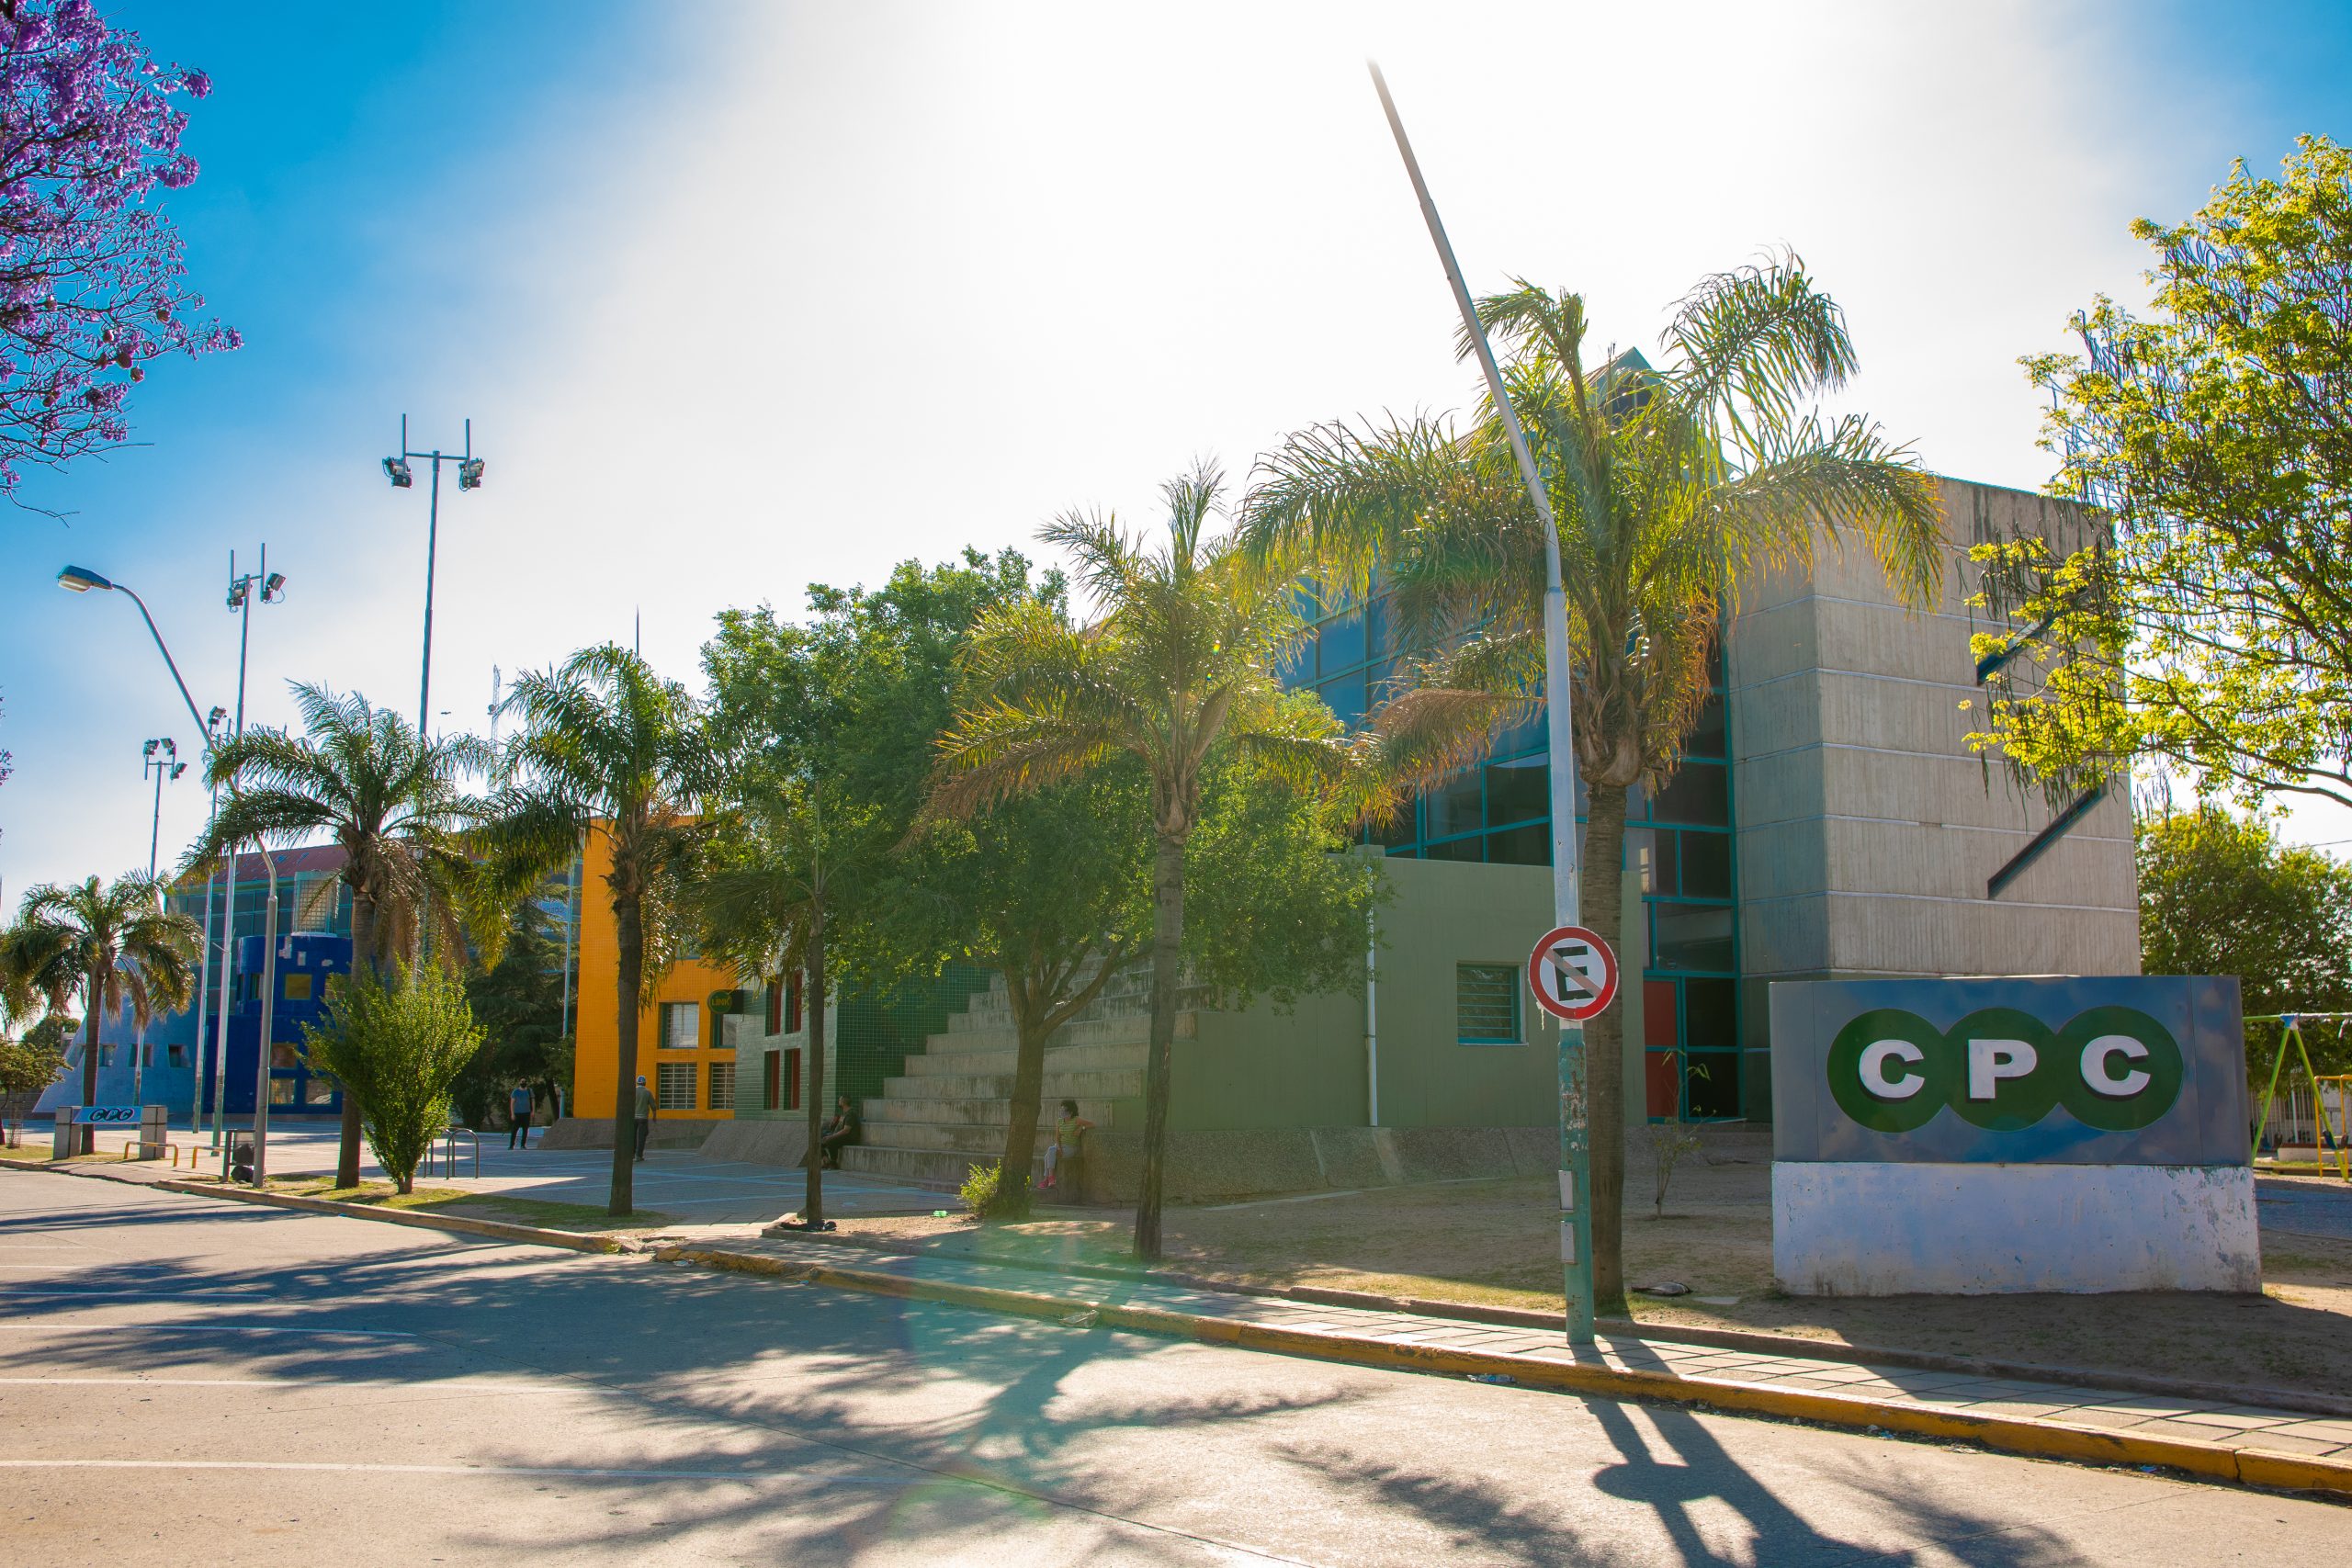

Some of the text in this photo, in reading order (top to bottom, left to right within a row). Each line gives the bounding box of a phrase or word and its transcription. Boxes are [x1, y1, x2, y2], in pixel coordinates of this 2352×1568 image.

[1553, 945, 1595, 1001] E
[1859, 1034, 2152, 1100] CPC
[93, 1109, 131, 1121] CPC
